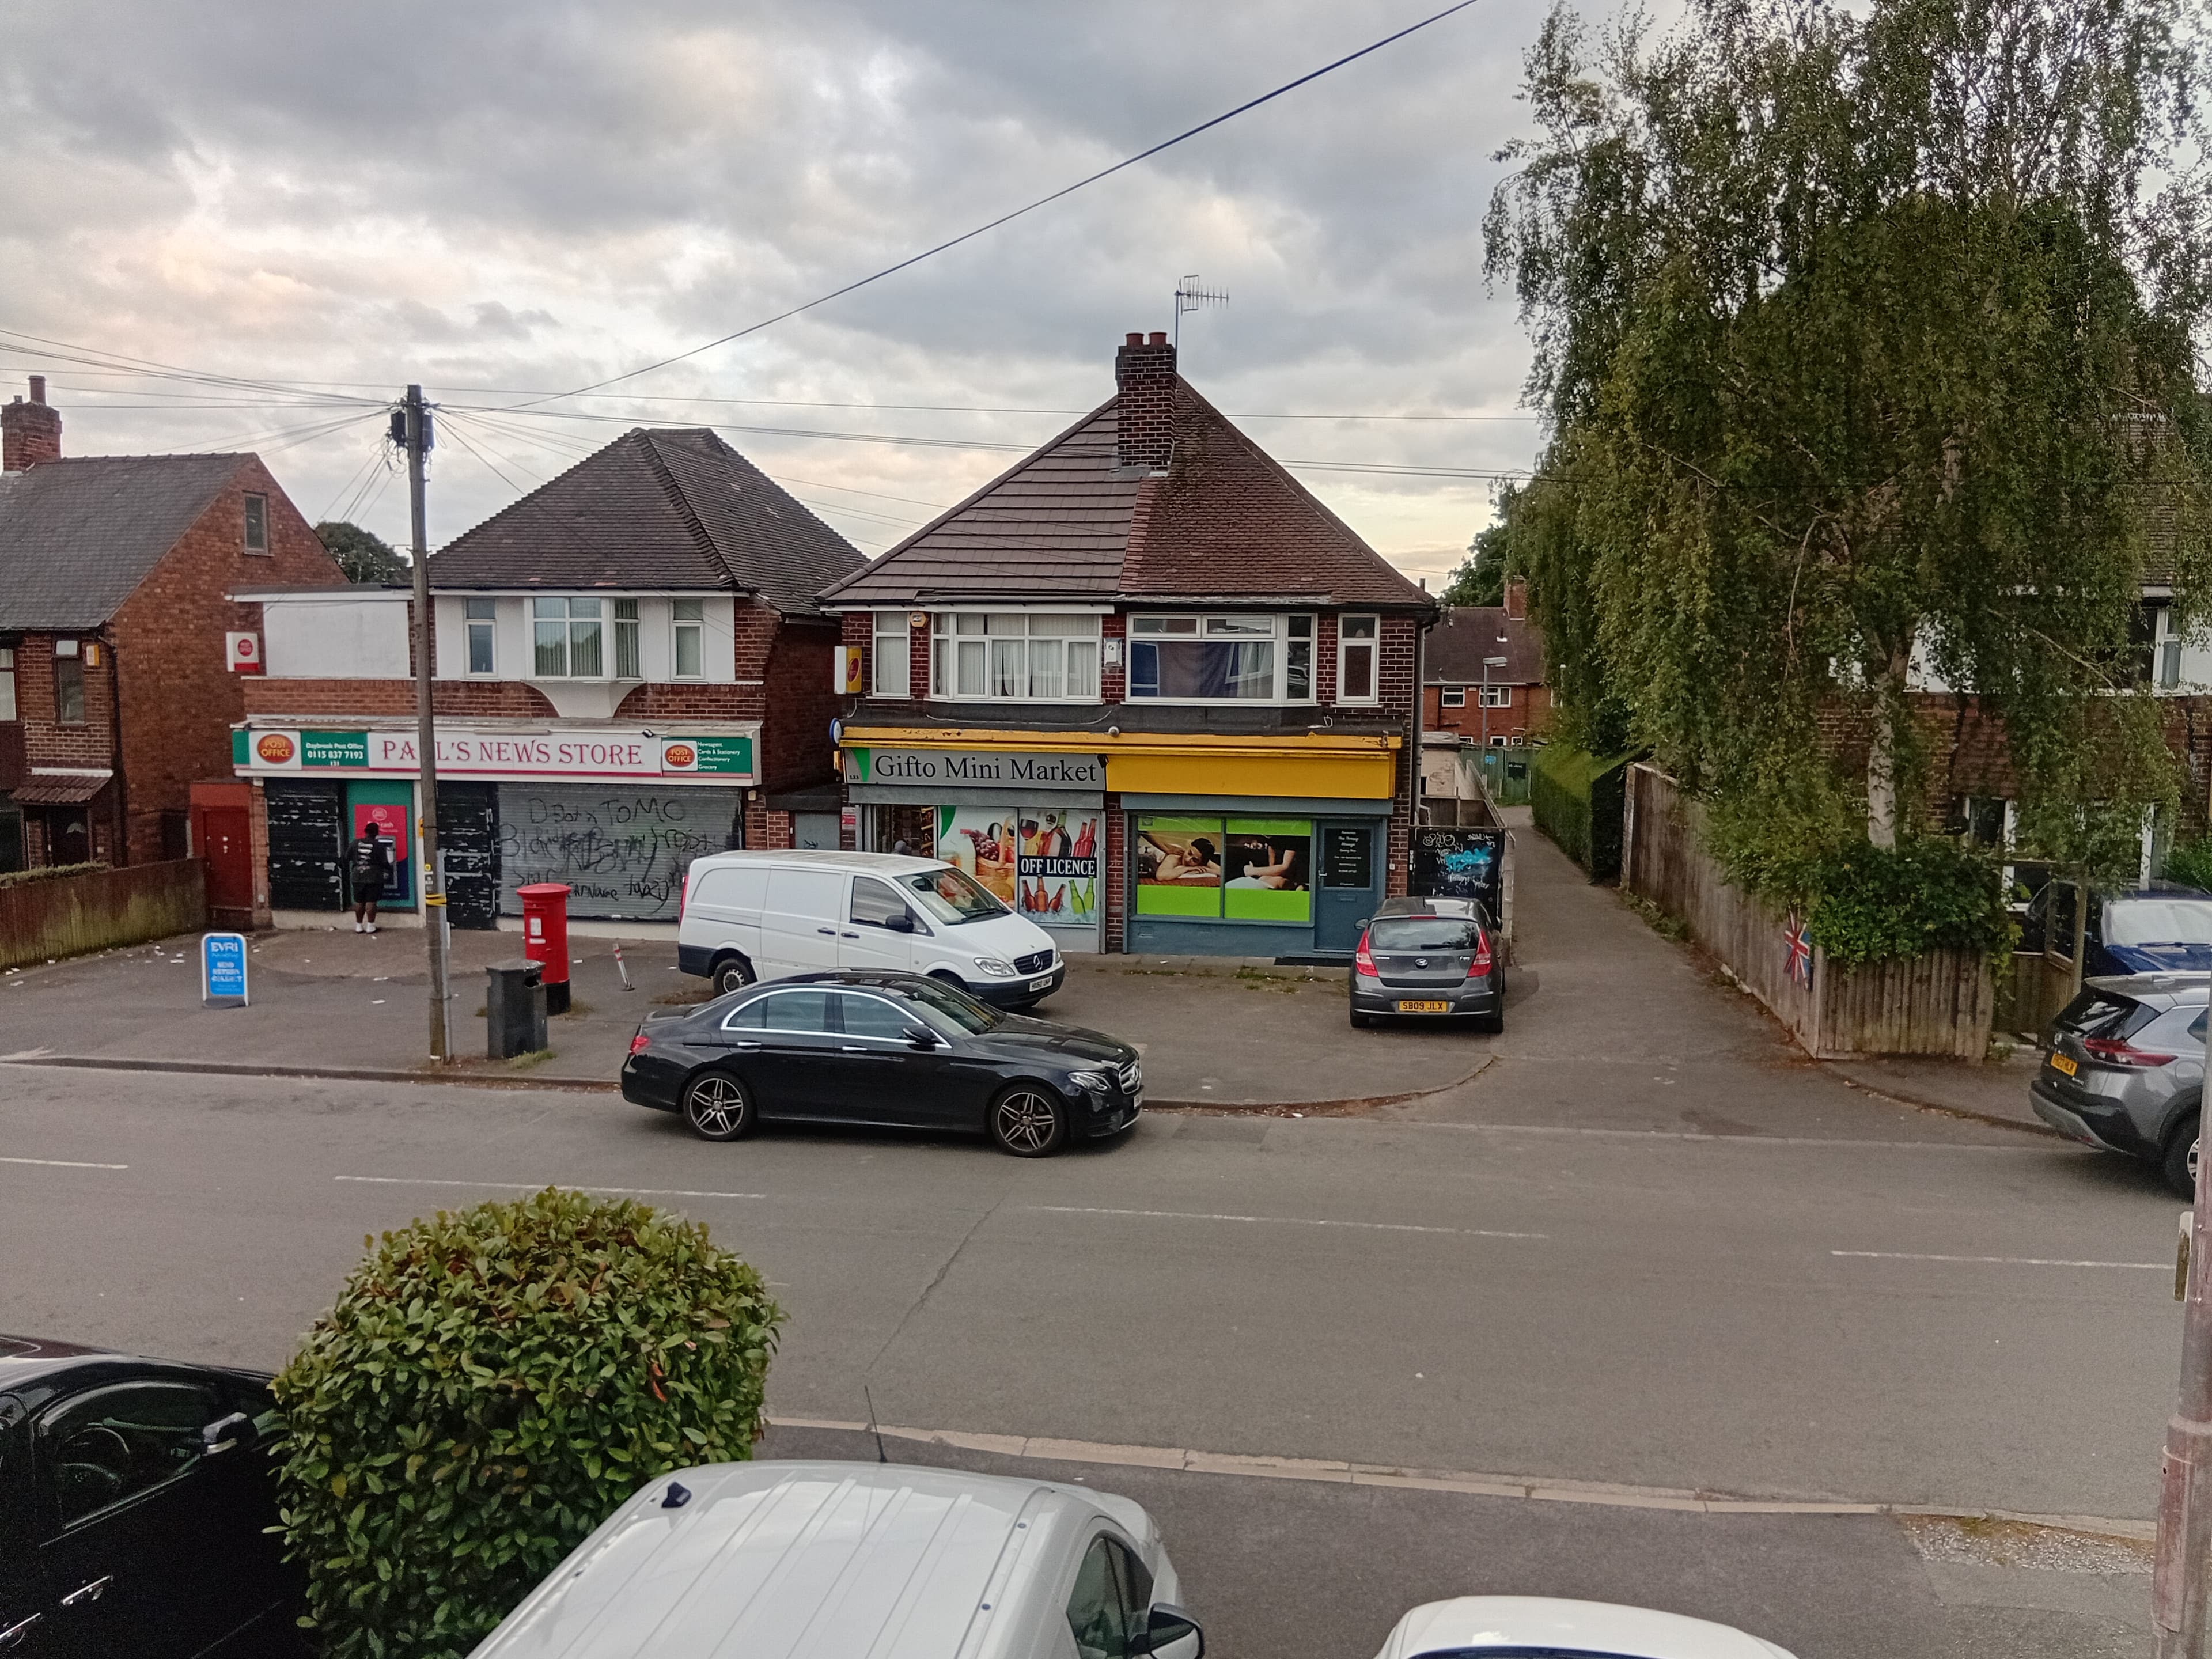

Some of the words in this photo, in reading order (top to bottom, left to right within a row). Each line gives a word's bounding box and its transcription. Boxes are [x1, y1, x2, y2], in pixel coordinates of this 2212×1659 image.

[264, 740, 286, 748] POST
[260, 749, 290, 757] OFFICE
[307, 751, 327, 759] 0115
[344, 751, 364, 759] 7193
[382, 740, 471, 761] PAL'S
[479, 740, 550, 764] NEWS
[559, 743, 642, 766] STORE
[875, 755, 936, 778] Gifto
[944, 756, 1001, 780] Mini
[1009, 758, 1096, 782] Market
[1021, 858, 1044, 873] OFF
[1046, 859, 1095, 875] LICENCE
[211, 942, 238, 952] EVRI
[1403, 1002, 1425, 1010] SB09
[1427, 1002, 1443, 1010] JLX
